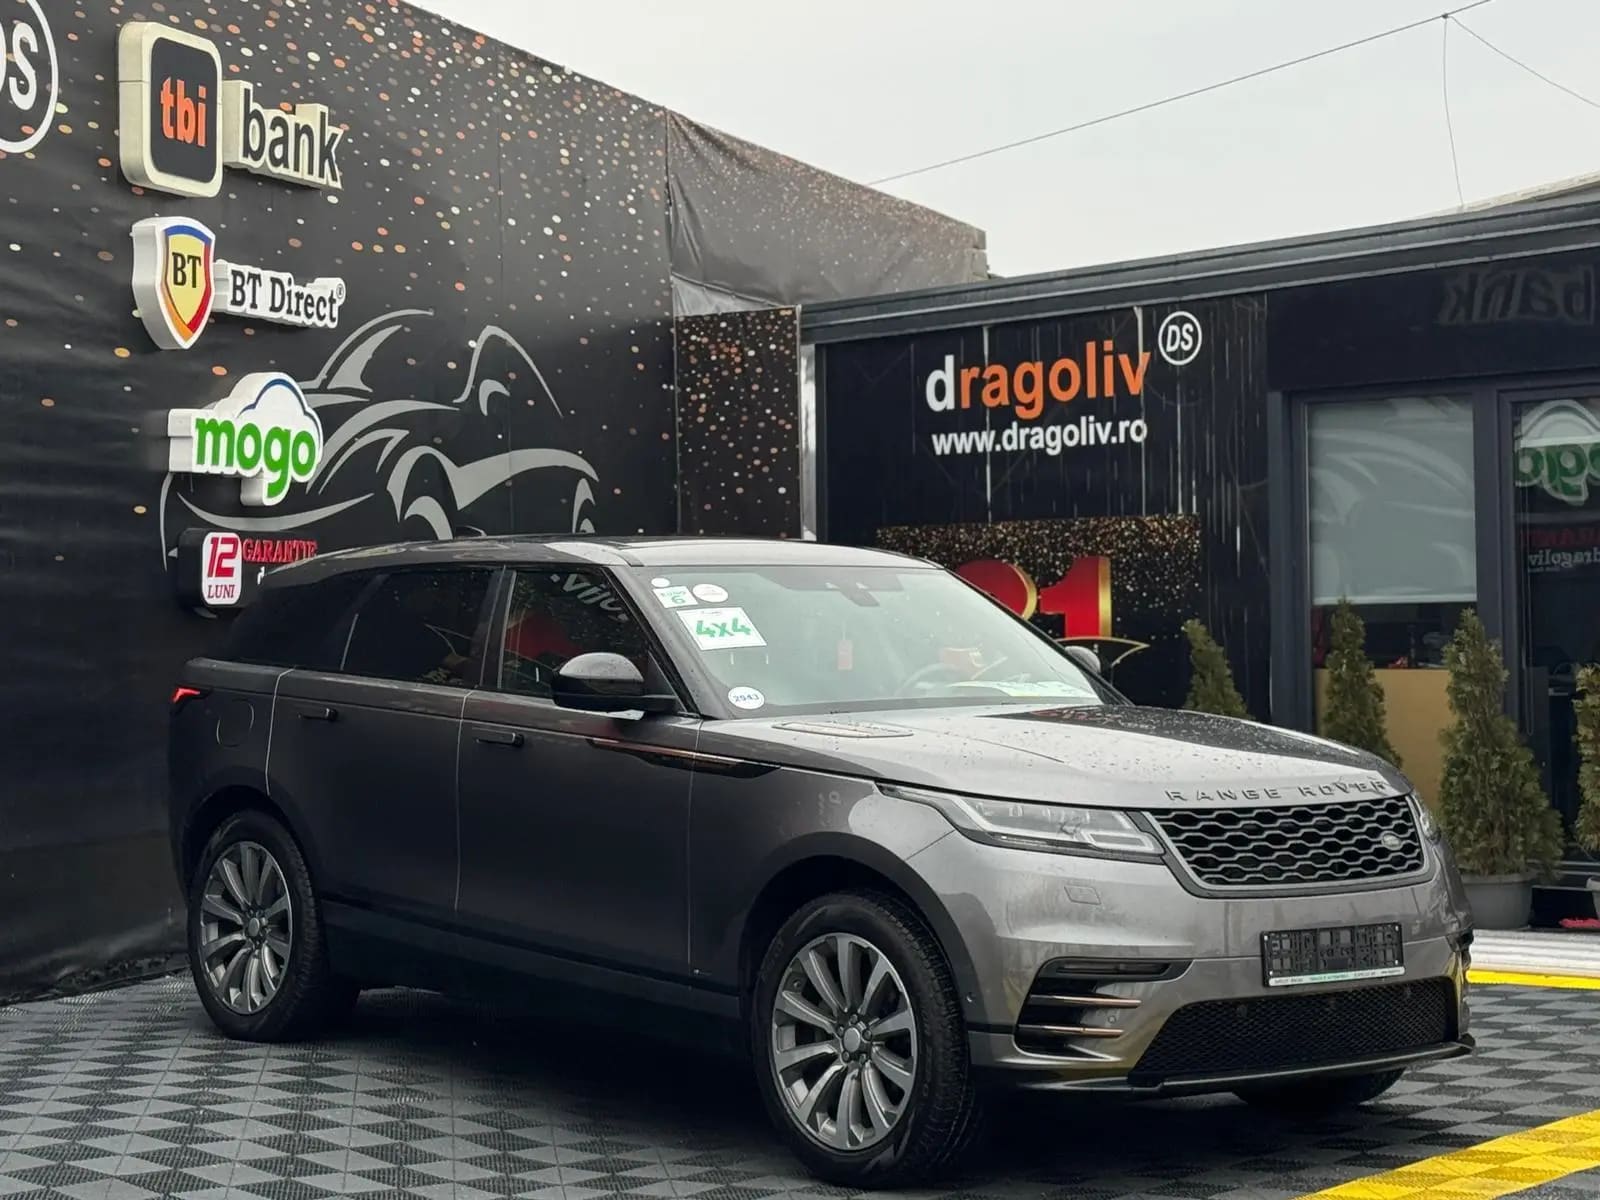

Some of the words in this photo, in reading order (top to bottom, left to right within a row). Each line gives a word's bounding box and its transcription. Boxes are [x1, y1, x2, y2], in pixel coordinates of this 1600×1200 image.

[0, 21, 38, 111] S
[160, 76, 207, 147] tbi
[242, 87, 341, 184] bank
[172, 251, 201, 288] BT
[230, 269, 261, 309] BT
[1166, 323, 1193, 352] DS
[926, 340, 1151, 420] dragoliv
[932, 416, 1147, 455] www.dragoliv.ro
[195, 418, 316, 498] mogo
[207, 537, 239, 578] 12
[207, 584, 235, 599] LUNI
[1165, 788, 1282, 801] RANGE
[1298, 778, 1389, 797] ROVER
